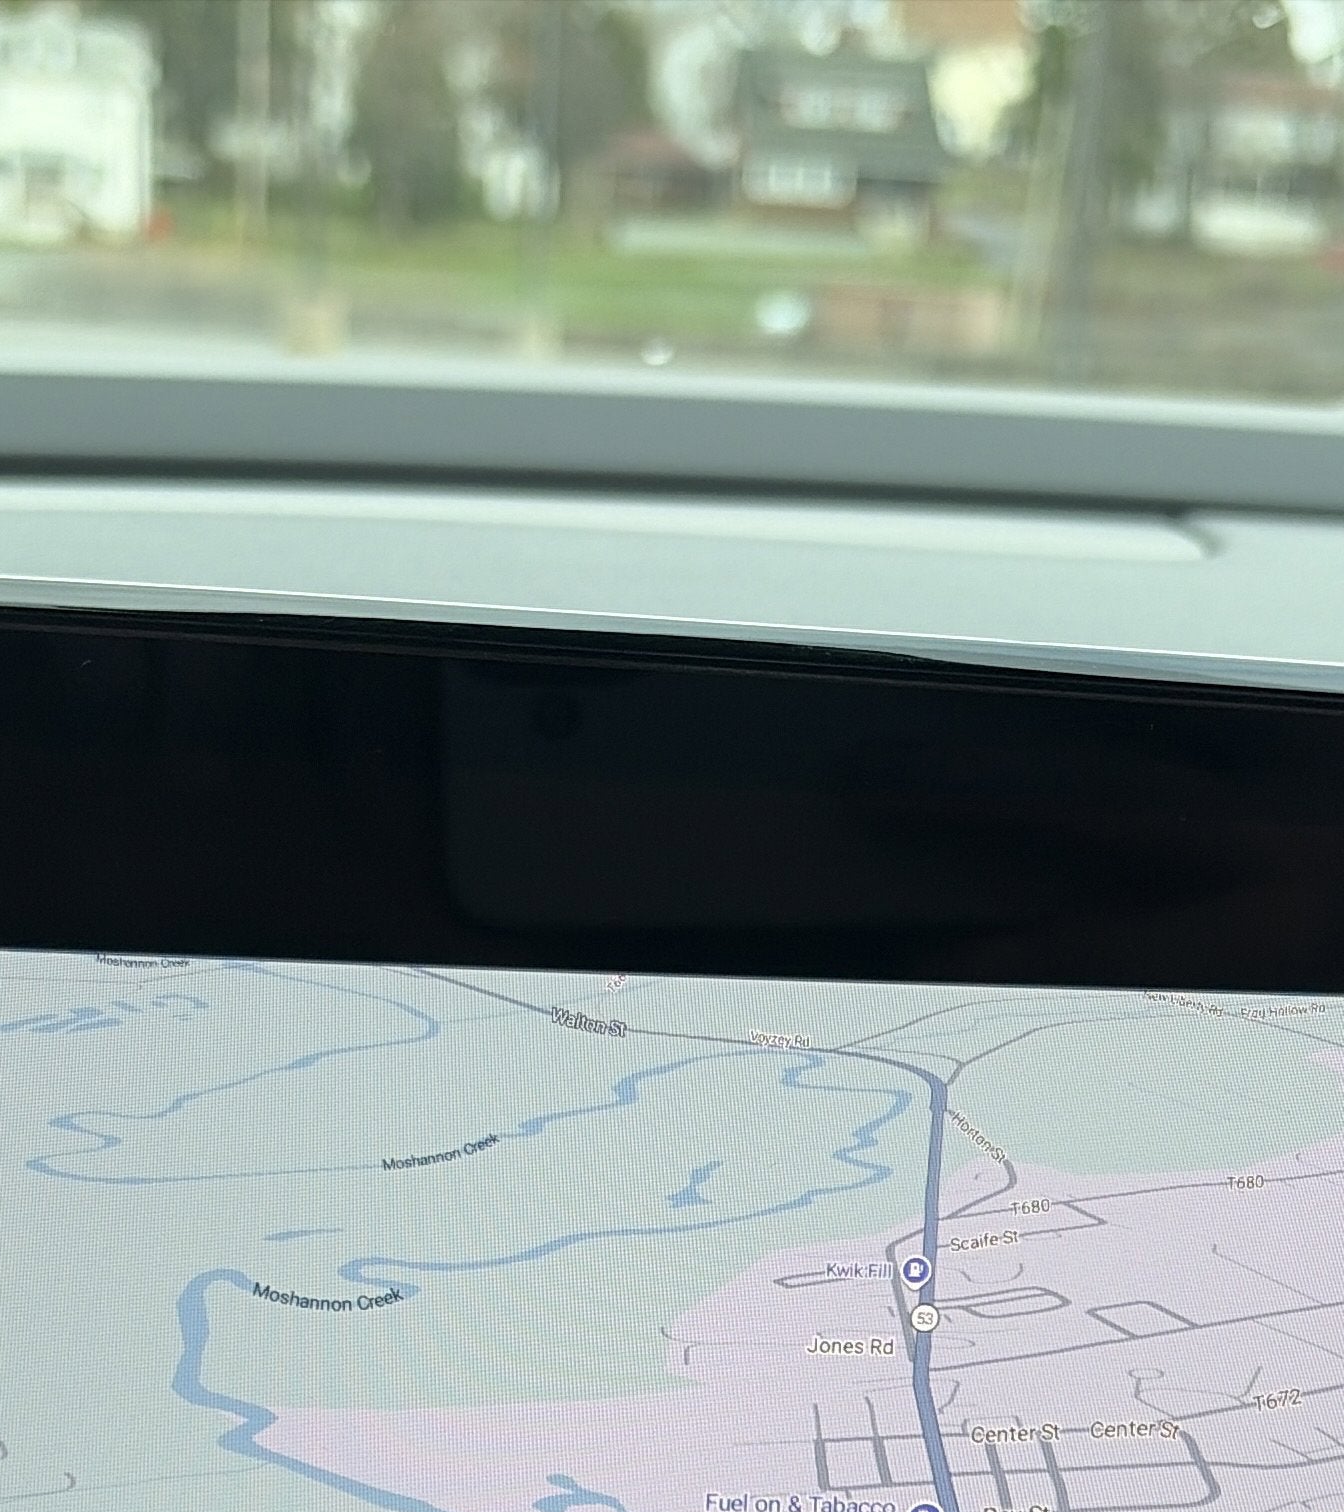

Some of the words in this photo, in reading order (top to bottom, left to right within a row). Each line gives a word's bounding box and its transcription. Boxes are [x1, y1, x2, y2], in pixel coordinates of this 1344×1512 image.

[552, 1007, 607, 1035] Walton
[607, 1020, 628, 1038] St
[794, 1032, 810, 1047] Rd
[382, 1144, 461, 1172] Moshannon
[462, 1132, 500, 1158] Creek
[1227, 1174, 1265, 1191] T680
[1010, 1198, 1051, 1217] T680
[950, 1231, 997, 1251] Scaife
[1000, 1230, 1020, 1245] St
[826, 1262, 864, 1278] Kwik
[868, 1262, 893, 1278] Fill
[253, 1281, 353, 1312] Moshannon
[355, 1287, 404, 1312] Creek
[807, 1338, 861, 1356] Jones
[862, 1337, 895, 1356] Rd
[970, 1425, 1036, 1446] Center
[1039, 1423, 1061, 1442] St
[1089, 1421, 1154, 1441] Center
[1159, 1420, 1180, 1440] St
